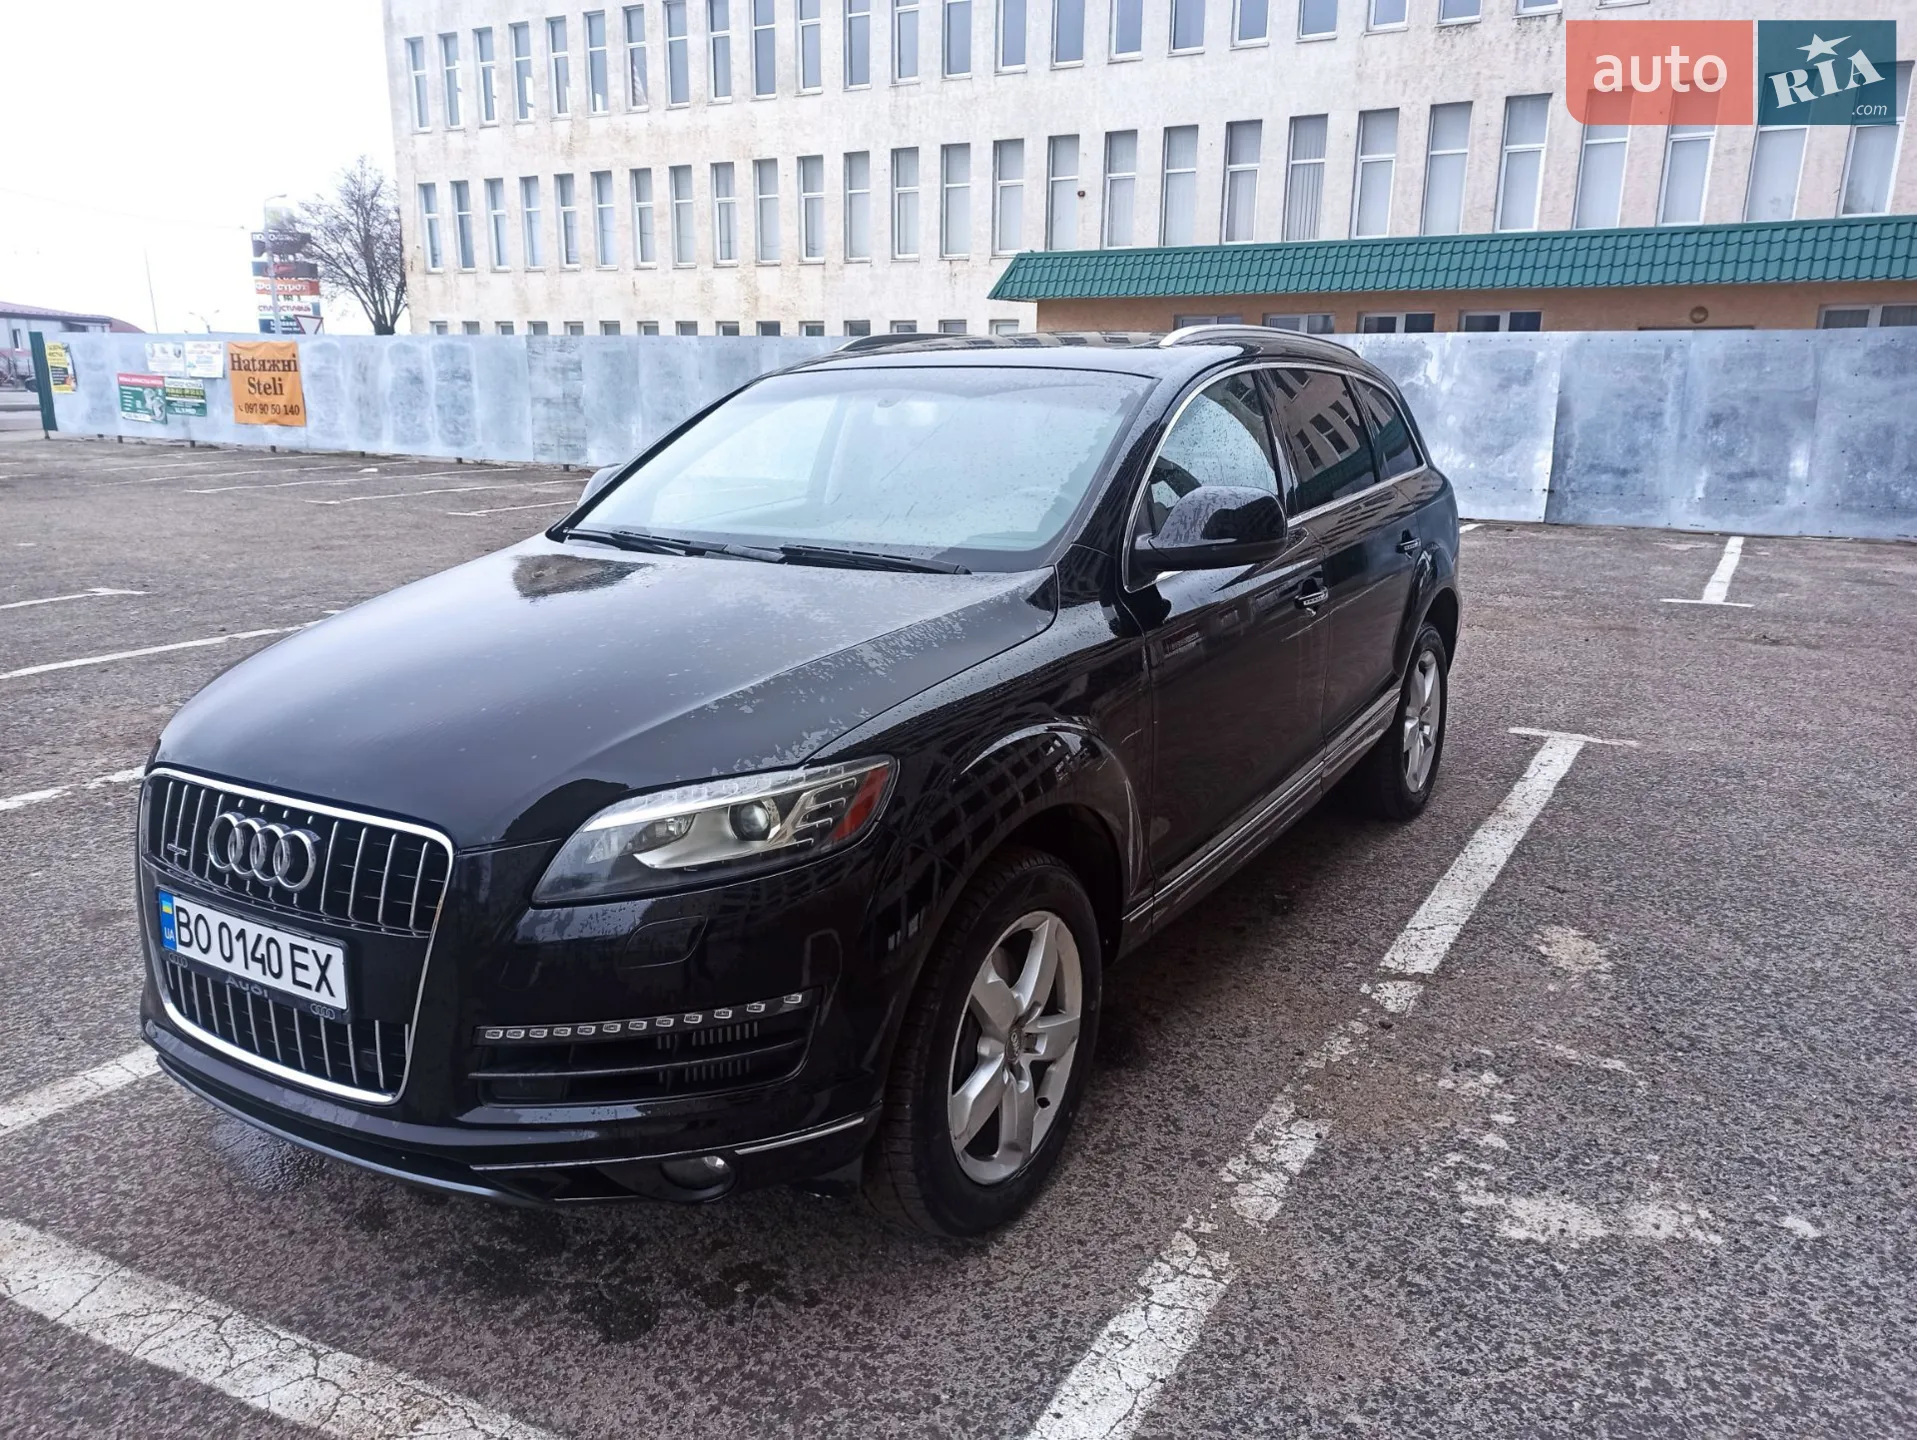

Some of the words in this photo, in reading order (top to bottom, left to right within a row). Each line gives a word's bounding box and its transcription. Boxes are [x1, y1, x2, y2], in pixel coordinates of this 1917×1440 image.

[247, 376, 284, 396] Steli
[270, 403, 281, 416] 50
[283, 404, 300, 416] 140
[164, 927, 175, 942] UA
[175, 905, 212, 955] BO
[217, 921, 284, 980] 0140
[289, 942, 337, 998] EX
